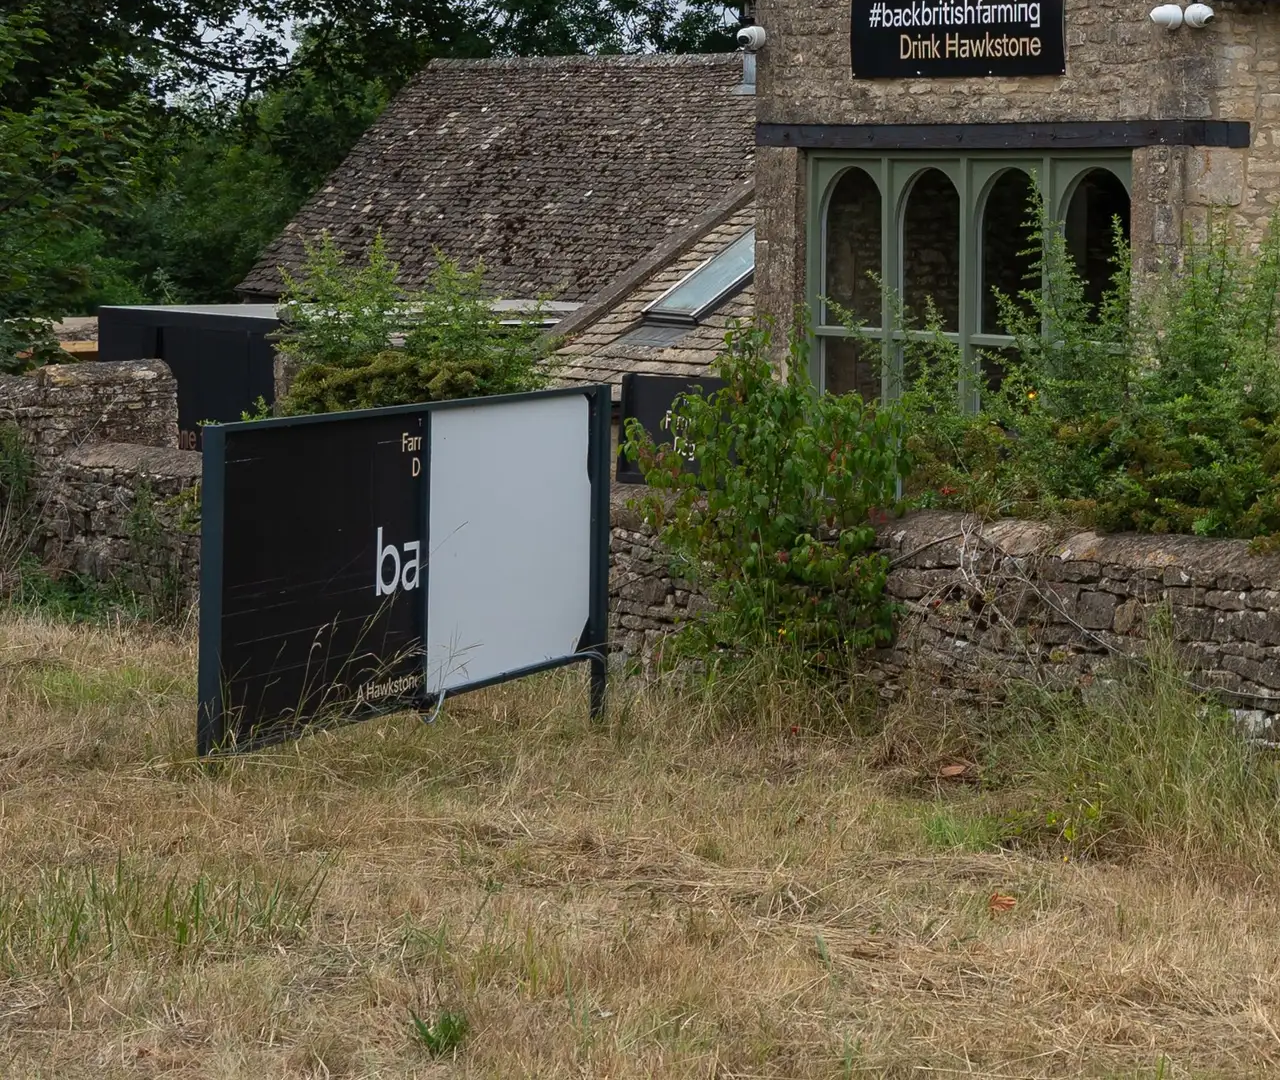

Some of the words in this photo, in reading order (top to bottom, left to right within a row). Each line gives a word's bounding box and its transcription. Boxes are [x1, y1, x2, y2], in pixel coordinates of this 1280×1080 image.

[900, 33, 941, 60] Drink
[945, 31, 1042, 59] Hawkstone
[375, 526, 421, 597] ba
